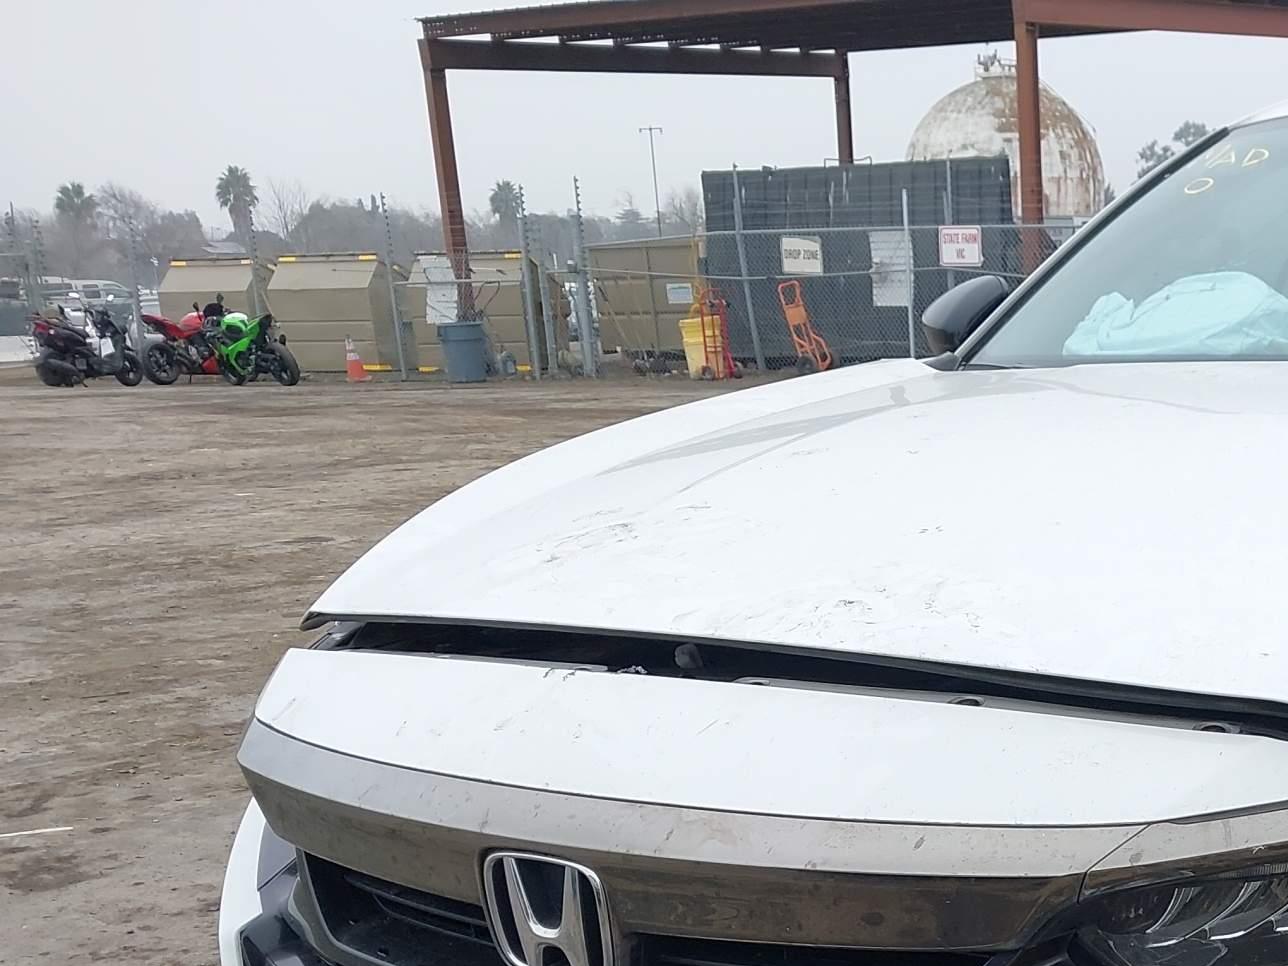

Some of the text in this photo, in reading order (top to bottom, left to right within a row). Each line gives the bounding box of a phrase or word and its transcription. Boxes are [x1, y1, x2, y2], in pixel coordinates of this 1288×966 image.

[943, 232, 960, 244] STATE
[783, 248, 819, 260] DROP ZONE
